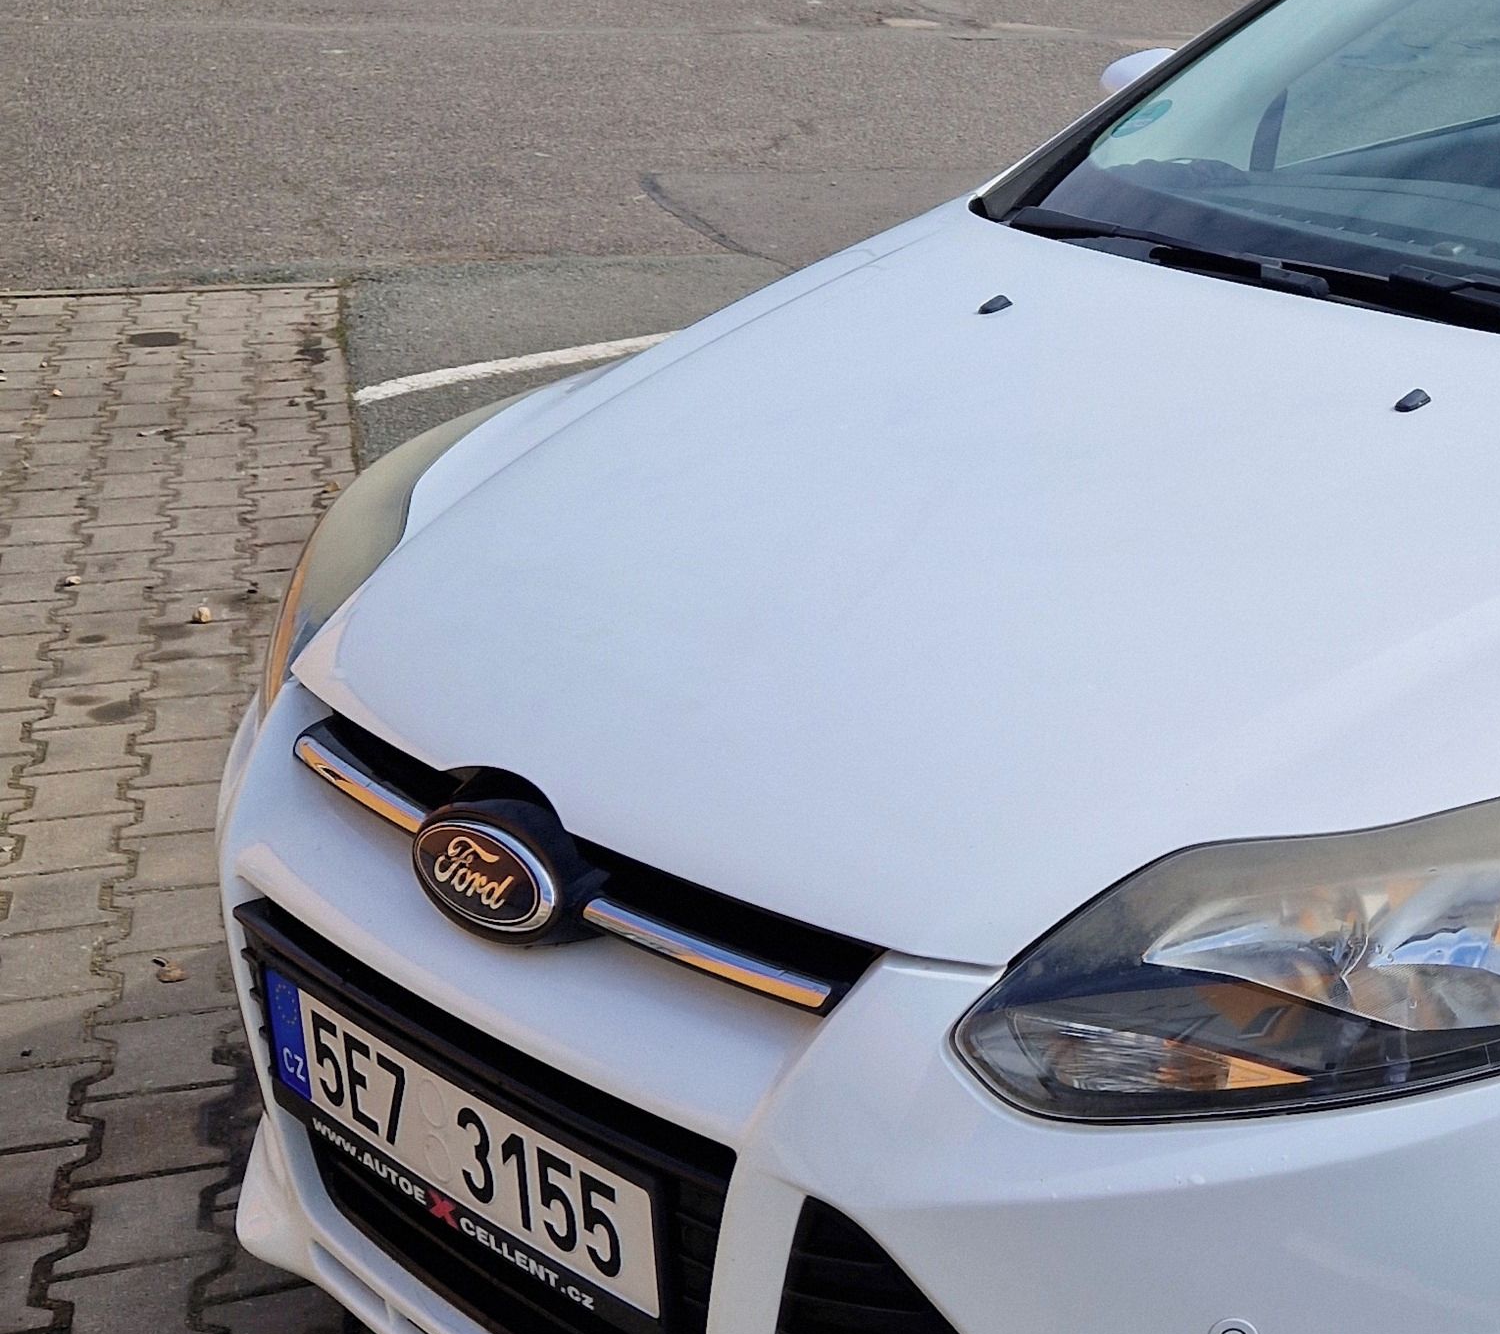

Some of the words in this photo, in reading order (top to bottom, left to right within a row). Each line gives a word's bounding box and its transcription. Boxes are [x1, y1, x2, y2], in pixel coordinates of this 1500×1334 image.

[433, 836, 514, 910] Ford
[282, 1047, 307, 1082] CZ
[310, 1009, 406, 1147] 5E7
[456, 1106, 622, 1279] 3155
